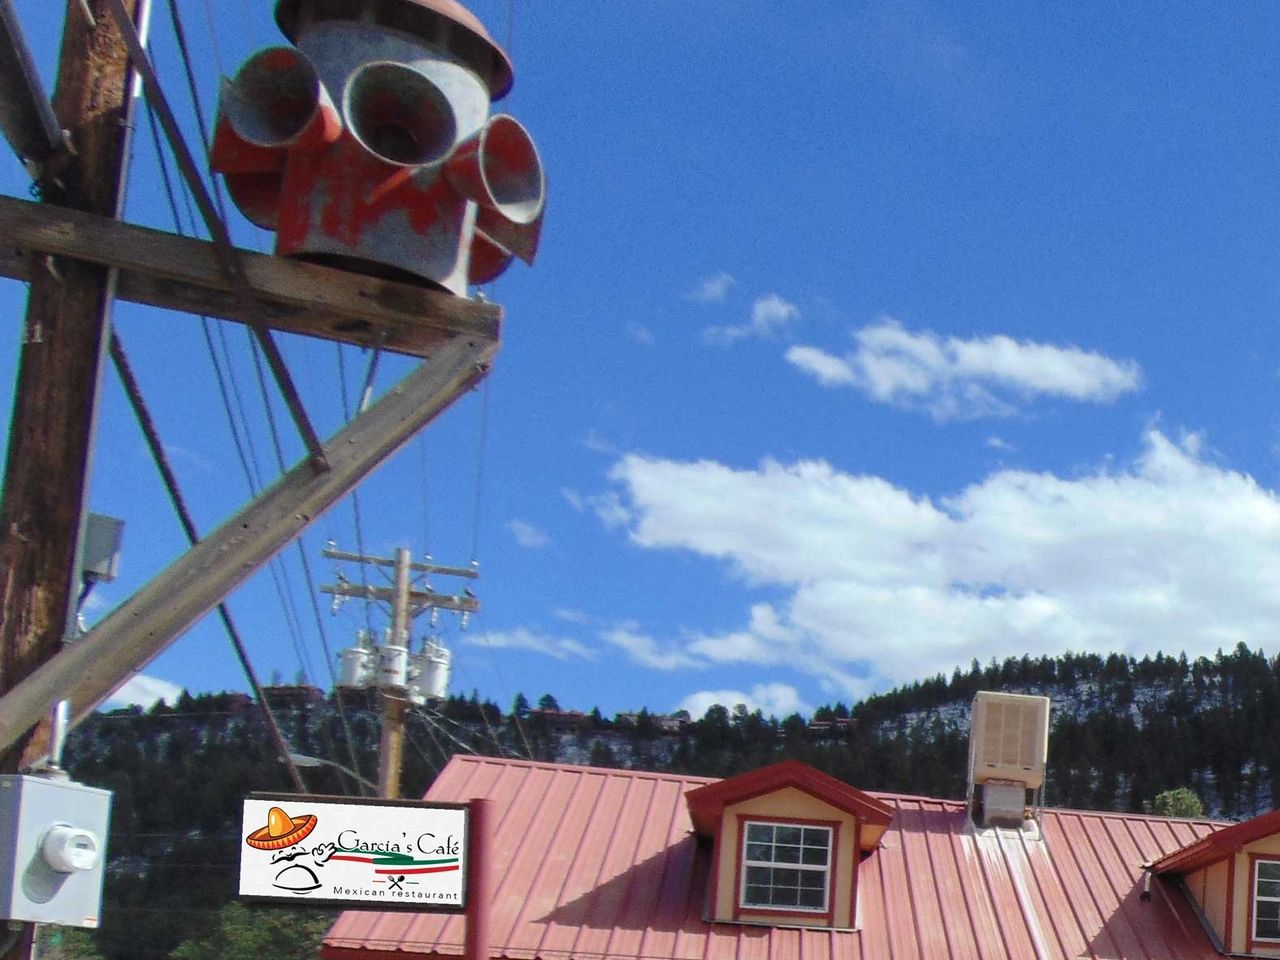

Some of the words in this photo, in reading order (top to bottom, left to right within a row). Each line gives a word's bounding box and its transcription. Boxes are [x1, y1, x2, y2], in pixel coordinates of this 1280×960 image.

[417, 832, 460, 854] Café
[333, 886, 385, 896] Mexican
[391, 890, 459, 900] restaurant
